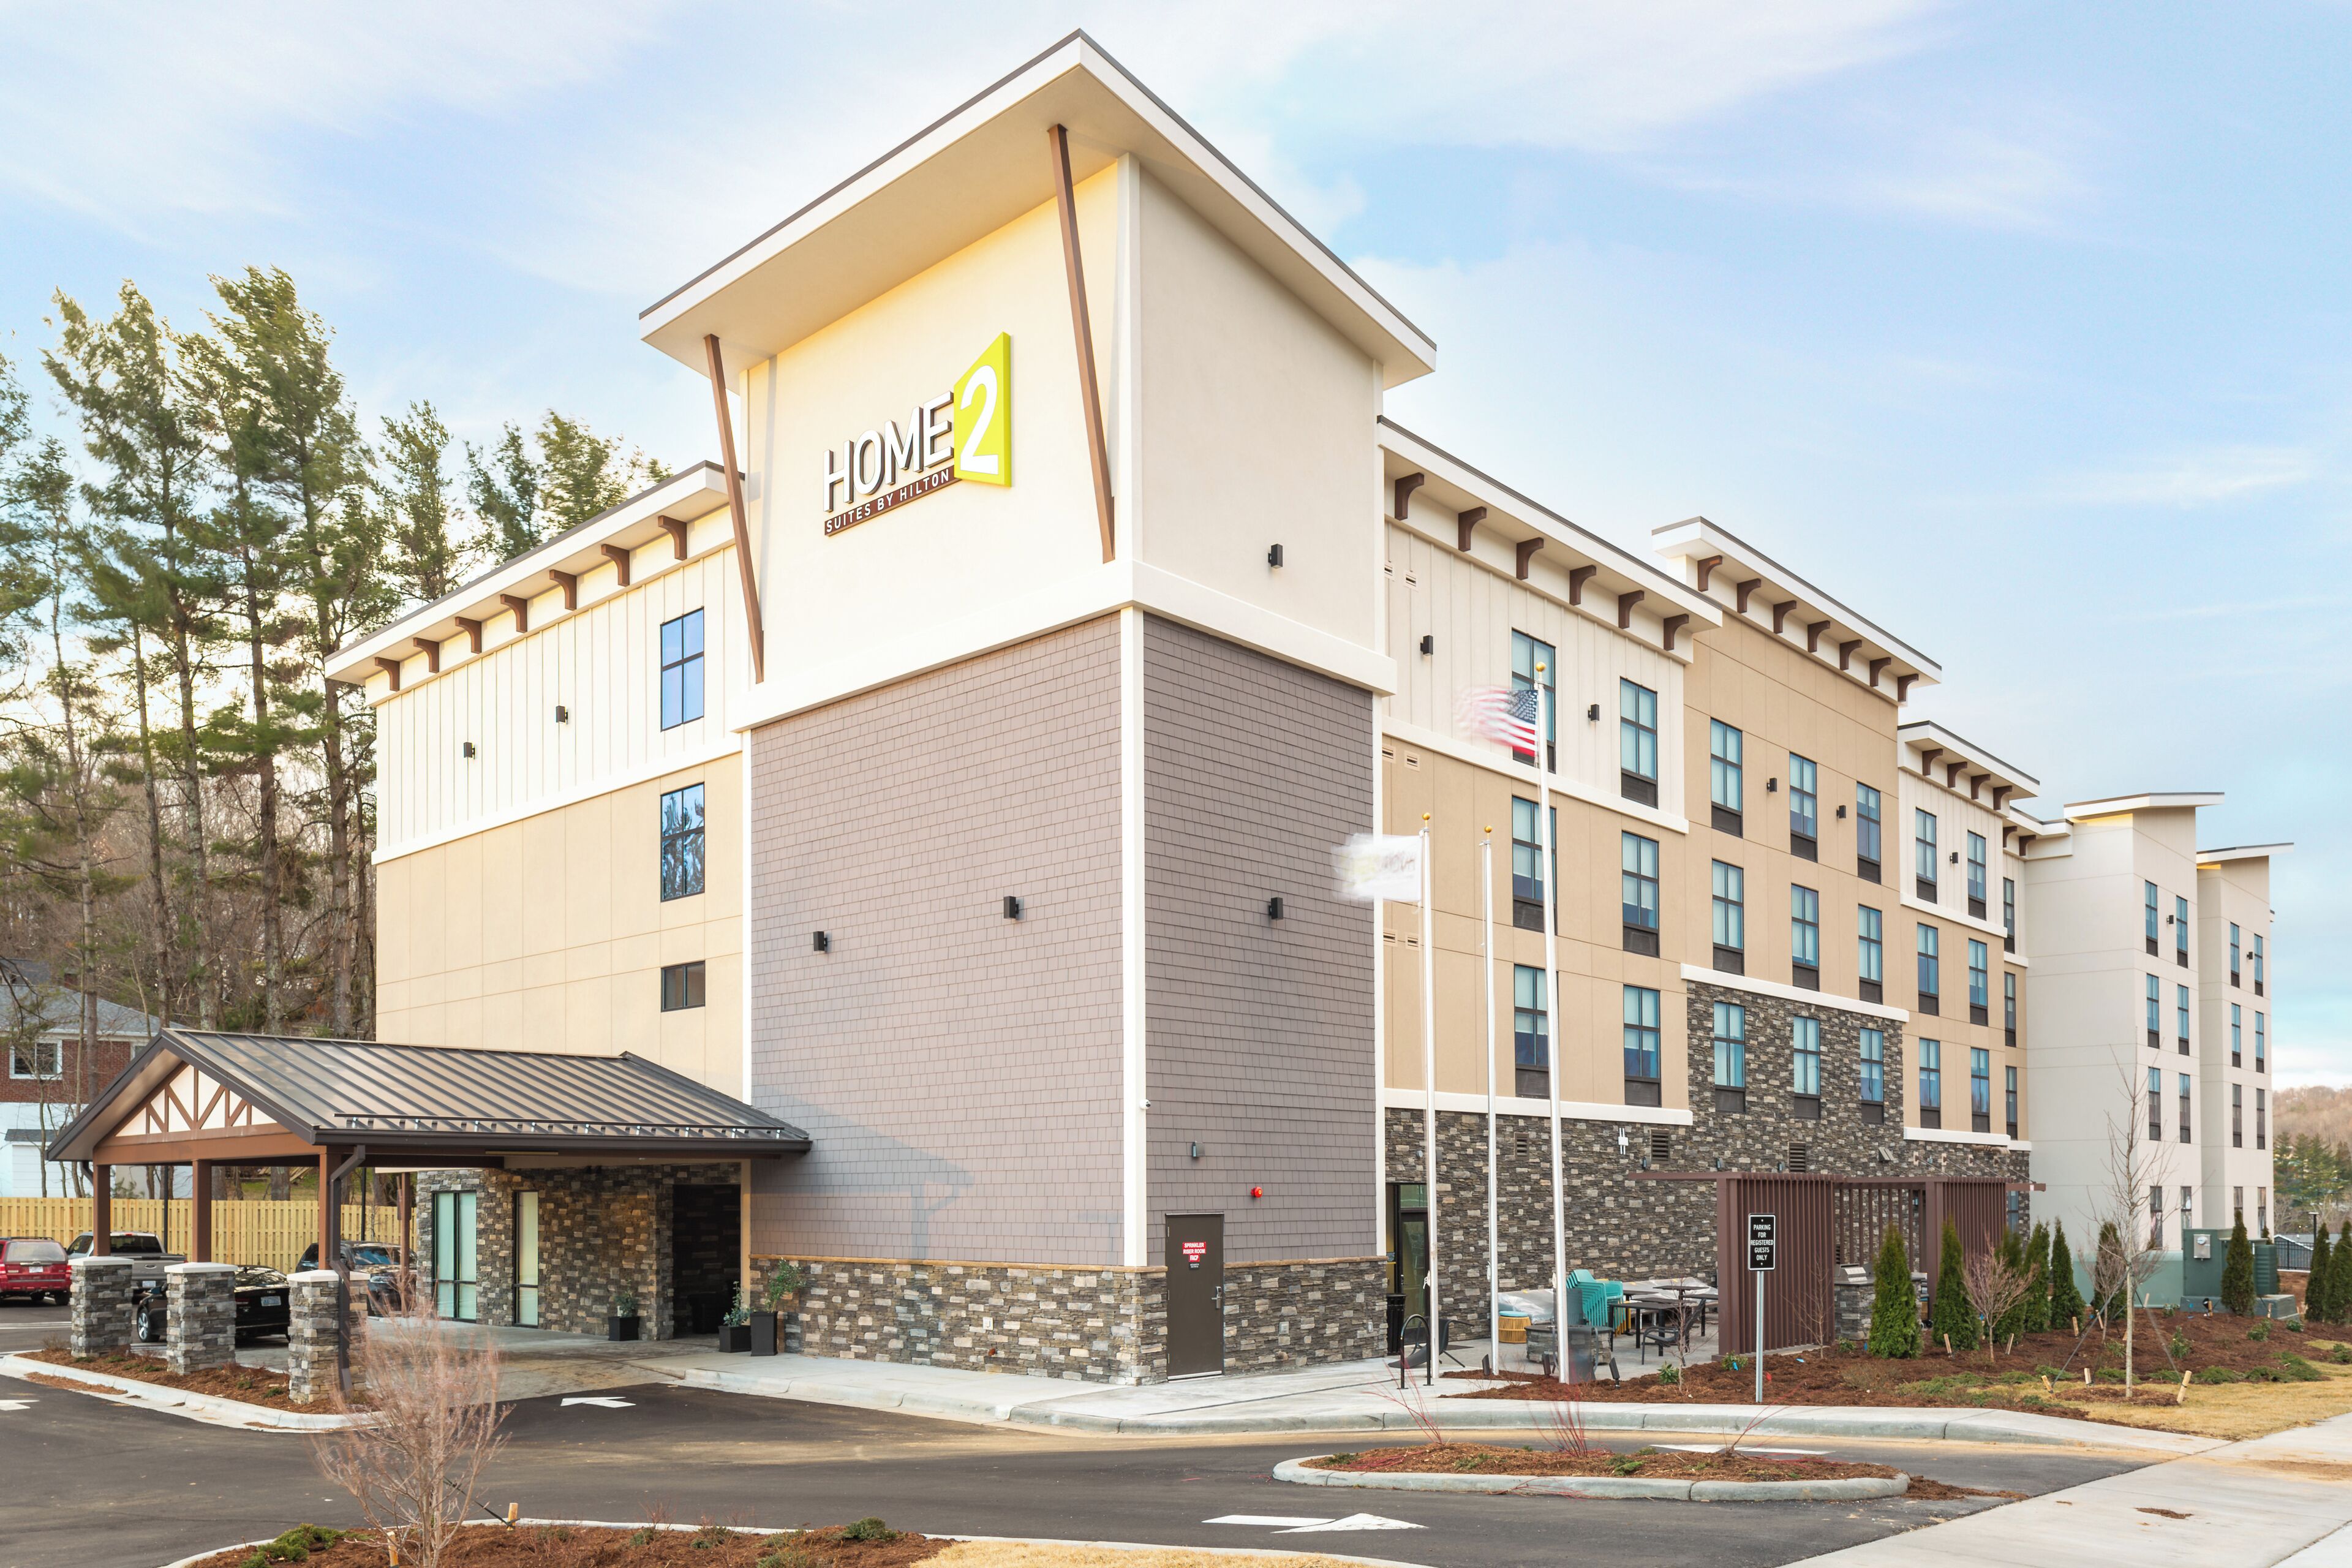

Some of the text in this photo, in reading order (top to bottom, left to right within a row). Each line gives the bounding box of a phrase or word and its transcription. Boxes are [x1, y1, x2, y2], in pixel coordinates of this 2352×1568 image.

[826, 469, 949, 533] SUITES BY HILTON
